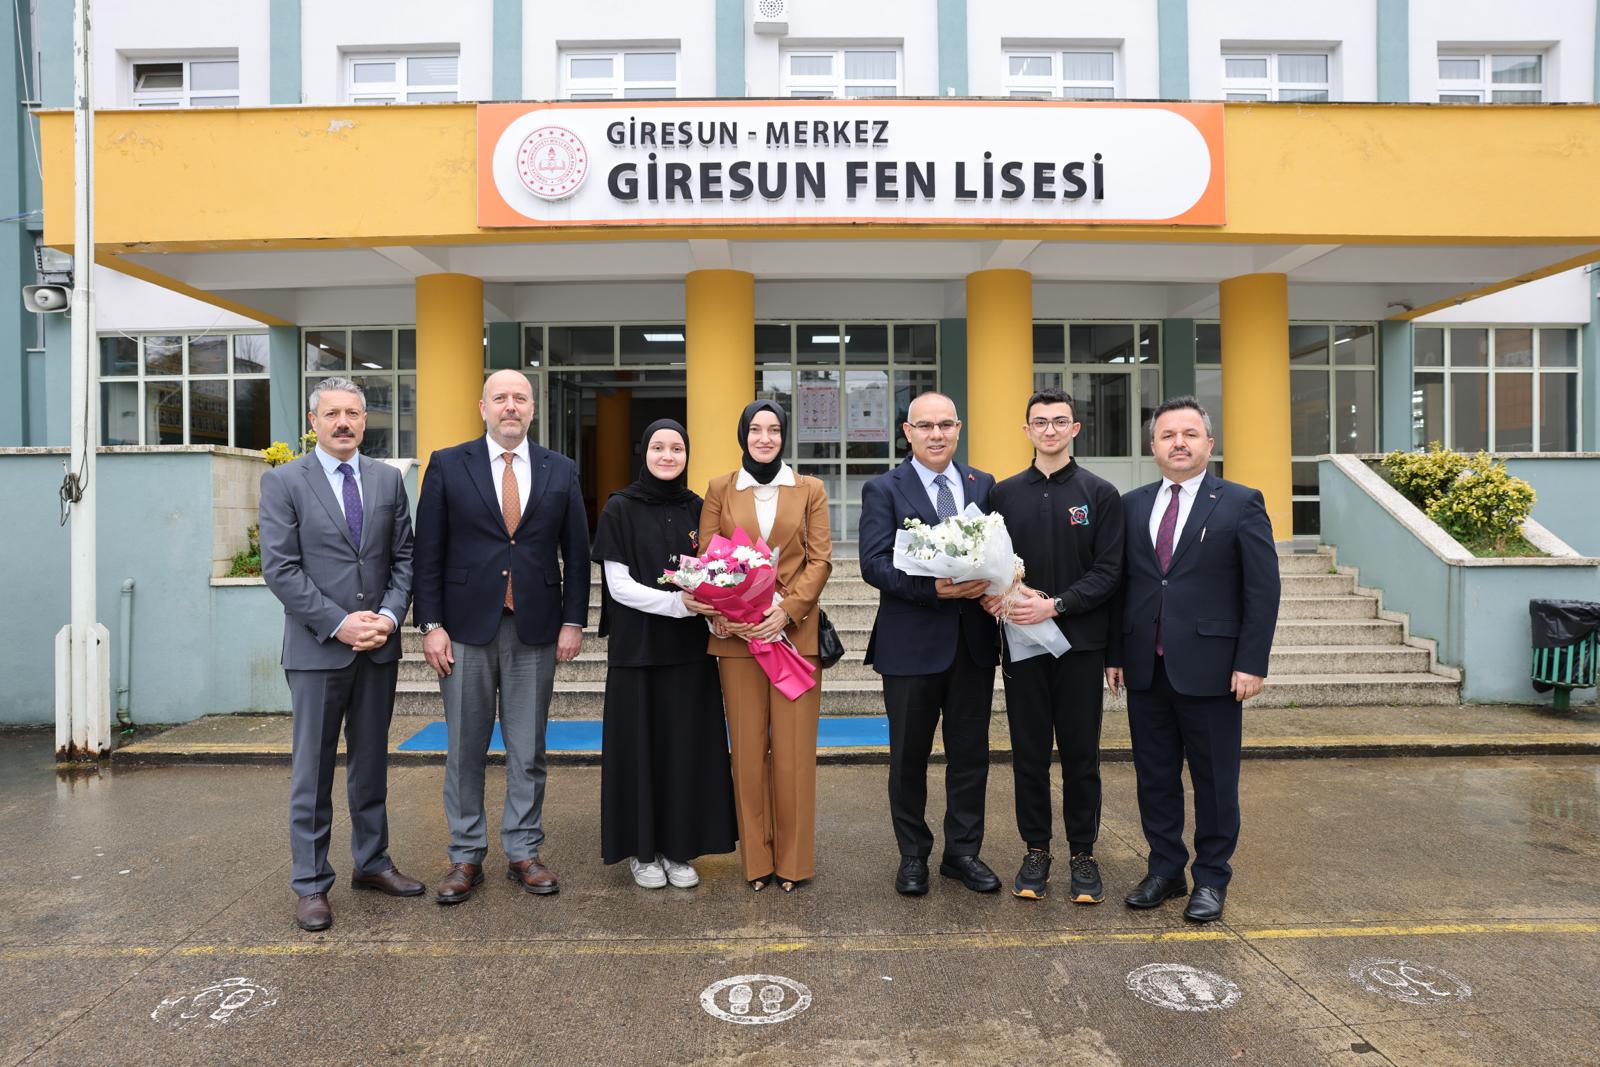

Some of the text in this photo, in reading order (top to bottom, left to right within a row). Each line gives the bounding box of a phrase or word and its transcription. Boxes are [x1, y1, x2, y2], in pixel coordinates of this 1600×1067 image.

[606, 116, 738, 146] GİRESUN
[766, 120, 889, 146] MERKEZ
[607, 152, 826, 201] GİRESUN
[846, 161, 936, 199] FEN
[954, 151, 1105, 200] LİSESİ
